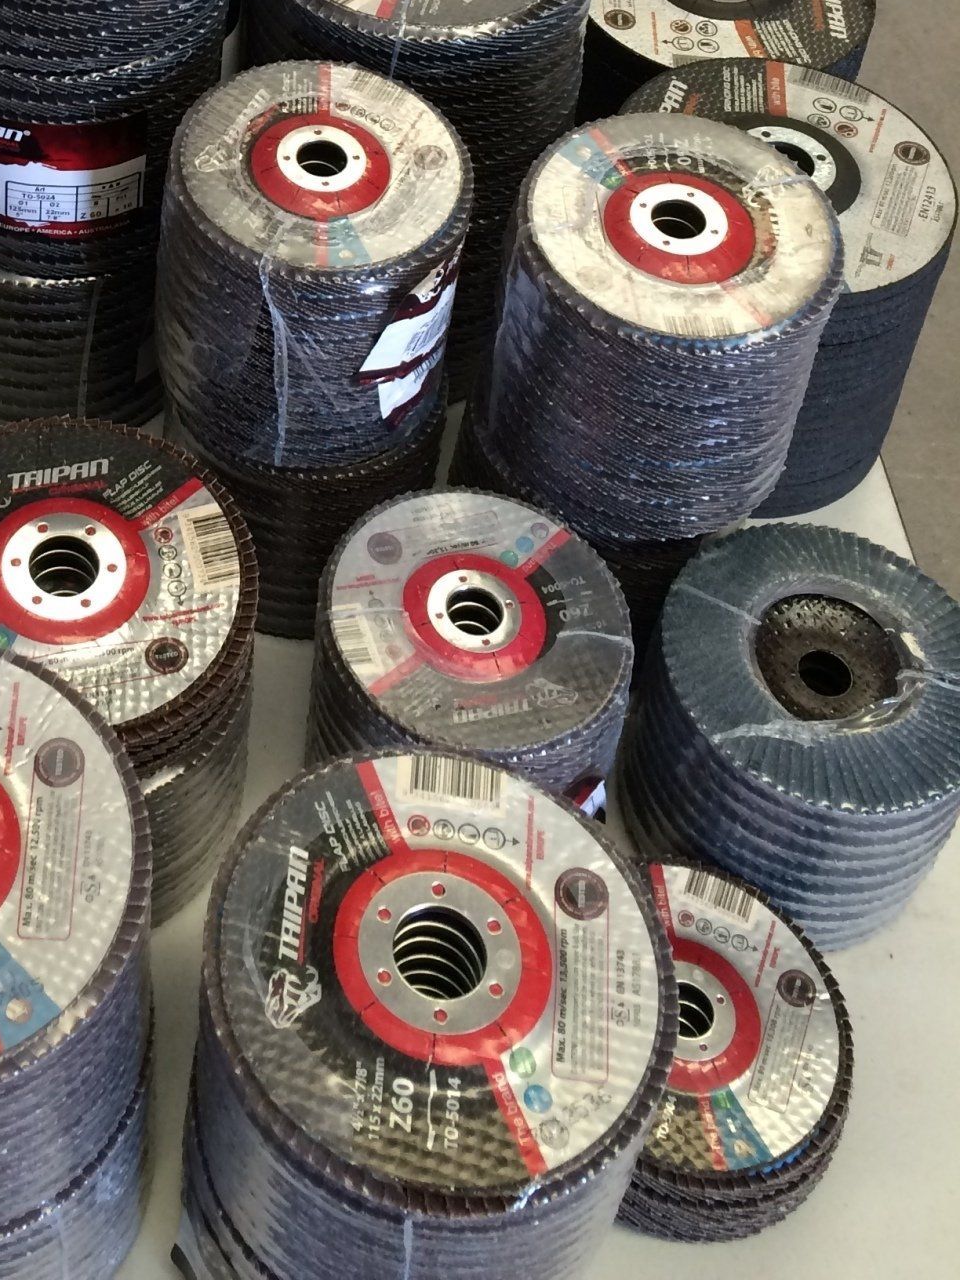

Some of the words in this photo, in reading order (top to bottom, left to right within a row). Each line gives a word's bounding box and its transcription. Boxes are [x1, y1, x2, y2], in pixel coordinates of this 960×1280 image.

[9, 205, 37, 214] 125mm
[21, 193, 56, 201] TO-5024
[917, 185, 937, 221] EN12413
[7, 457, 110, 492] TAIPAN
[102, 478, 129, 500] FLAP
[129, 459, 153, 482] DISC
[277, 845, 310, 961] TAIPAN
[559, 928, 570, 949] rpm
[557, 988, 568, 1019] m/sec
[556, 1021, 567, 1034] 80
[555, 1036, 567, 1063] Max.
[389, 1076, 415, 1133] Z60
[443, 1076, 461, 1150] TO-5014
